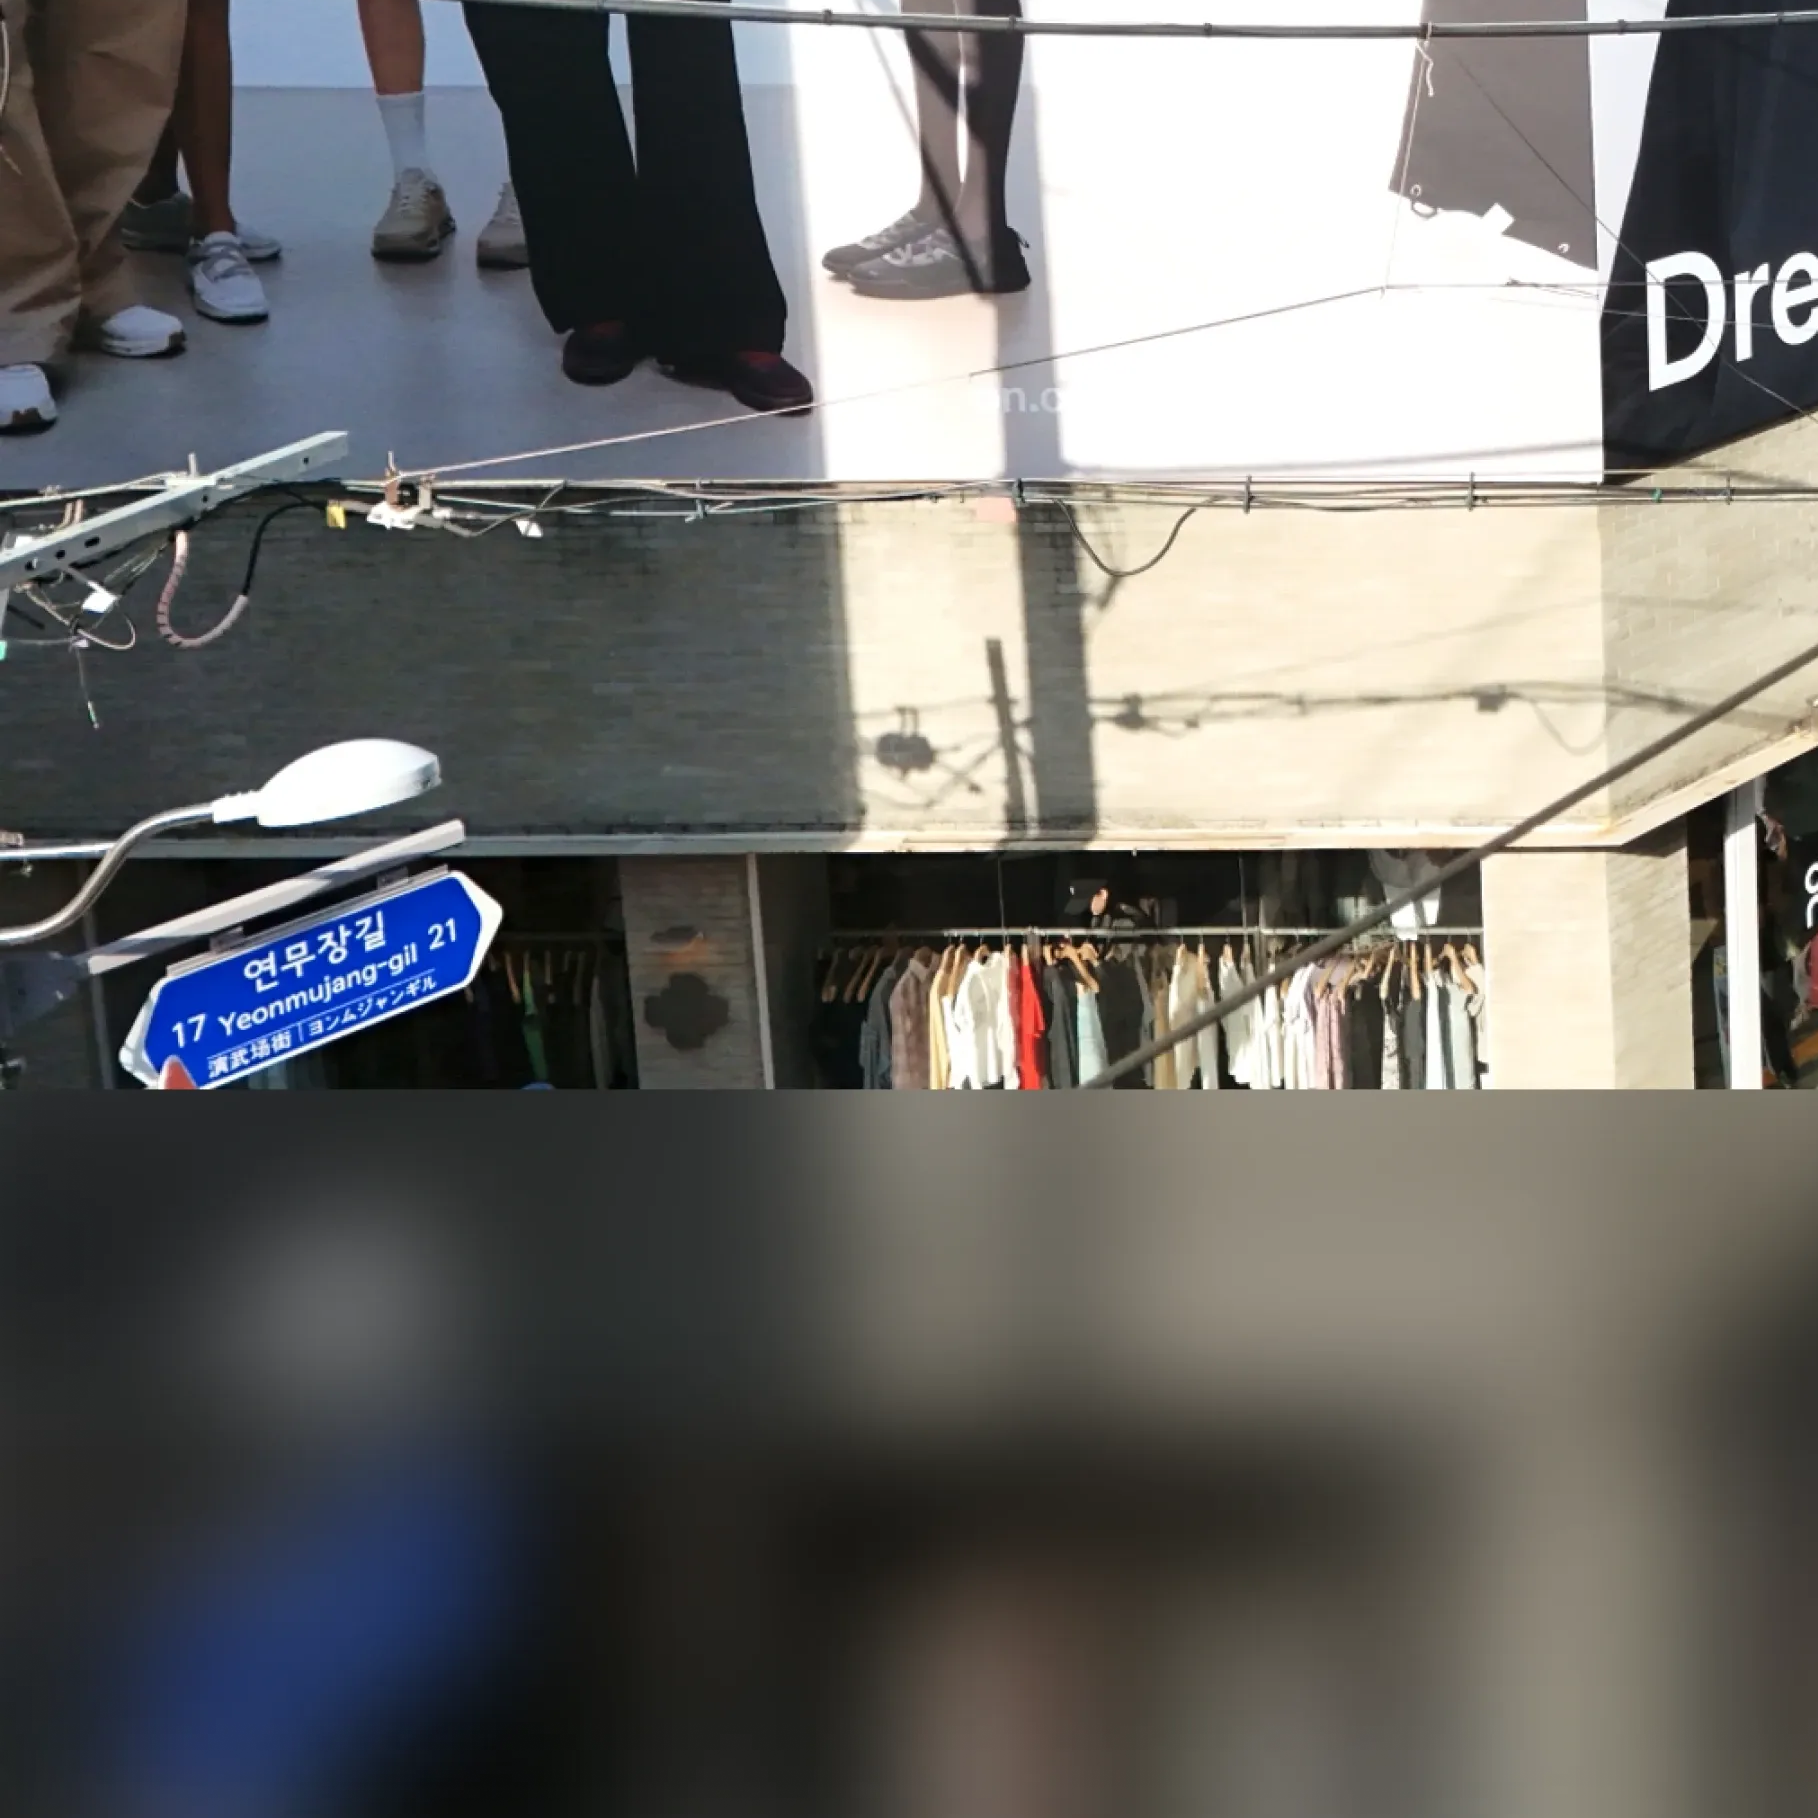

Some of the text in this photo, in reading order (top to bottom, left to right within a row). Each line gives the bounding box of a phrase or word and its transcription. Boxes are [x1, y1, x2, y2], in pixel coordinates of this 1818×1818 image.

[172, 917, 457, 1049] 17 Yeonmujang-gil 21
[243, 910, 387, 994] 연무장길
[308, 975, 437, 1037] ヨンムジャンギル
